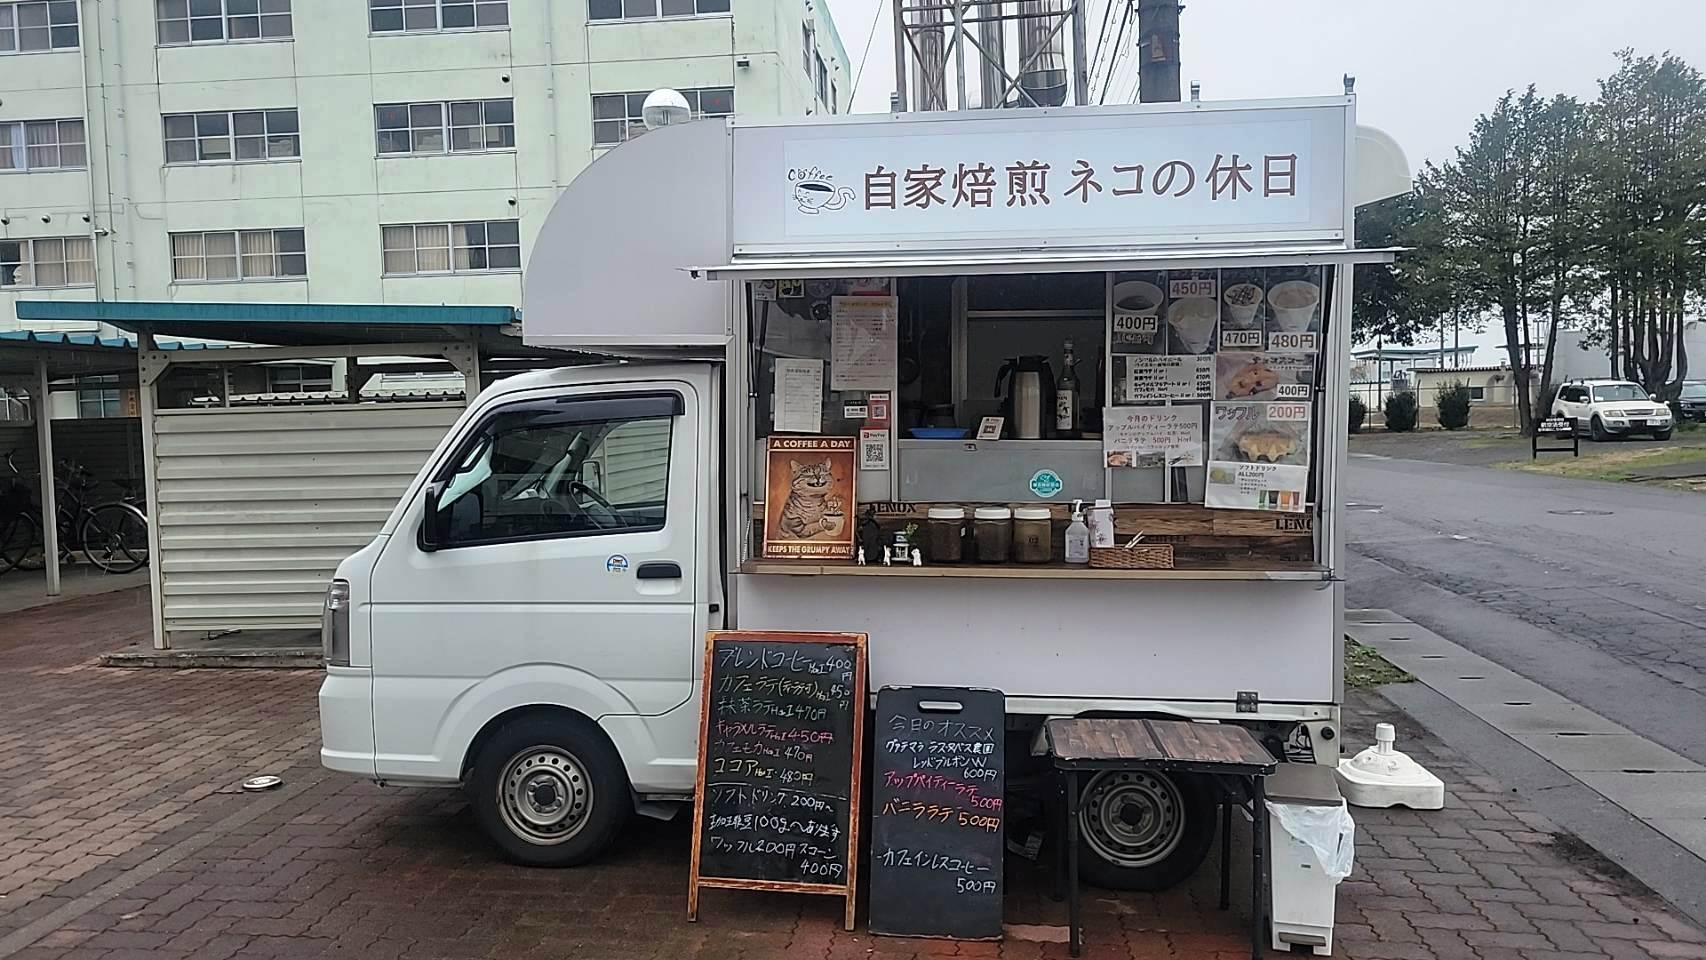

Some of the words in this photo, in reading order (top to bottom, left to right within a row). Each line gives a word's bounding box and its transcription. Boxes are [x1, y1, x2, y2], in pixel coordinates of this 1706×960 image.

[1172, 282, 1212, 296] 450円
[1117, 316, 1156, 331] 400円
[1225, 332, 1260, 345] 470円
[1272, 334, 1314, 348] 480円
[1278, 385, 1308, 396] 400円
[1268, 406, 1306, 419] 200円
[773, 440, 781, 448] A
[783, 440, 818, 448] COFFEE
[820, 440, 829, 448] A
[830, 440, 851, 448] DAY
[767, 545, 786, 553] KEEPS
[788, 545, 800, 553] THE
[801, 546, 830, 554] GRUMPY
[831, 546, 850, 554] AWAY
[889, 714, 994, 741] 今日のオススメ
[963, 767, 998, 782] 600円
[970, 795, 1003, 811] 500円
[882, 798, 954, 823] バニララテ
[958, 811, 1001, 833] 500円
[800, 858, 843, 879] 400円
[956, 877, 997, 894] 500円
